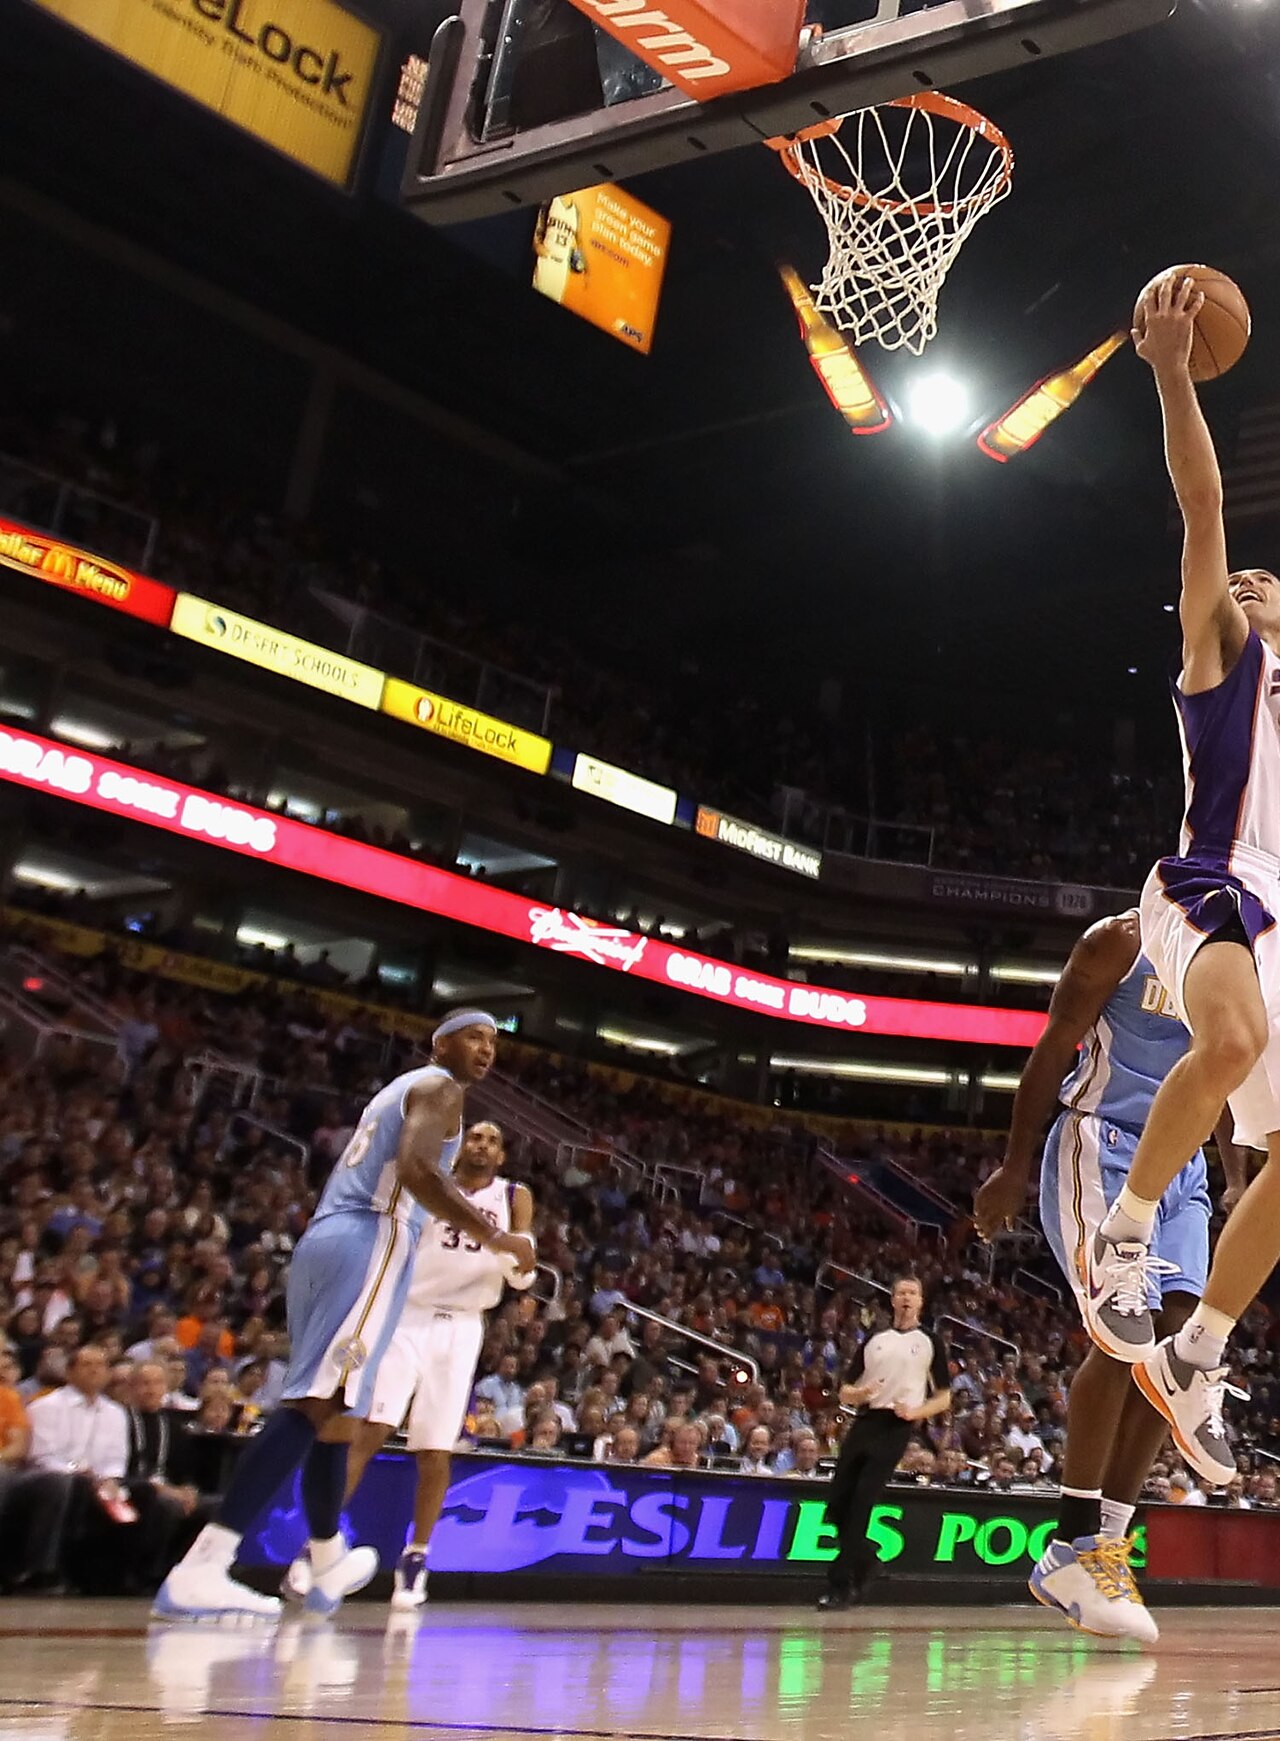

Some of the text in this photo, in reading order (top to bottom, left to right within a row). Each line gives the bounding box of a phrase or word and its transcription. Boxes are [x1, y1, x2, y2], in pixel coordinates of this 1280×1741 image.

[591, 220, 618, 245] plan
[595, 208, 663, 257] green game
[597, 192, 656, 238] Make your
[75, 560, 128, 602] Menu
[231, 623, 289, 659] DESERT
[294, 649, 359, 688] SCHOOLS
[437, 702, 518, 752] LifeLock
[783, 845, 820, 877] BANK
[931, 883, 1051, 908] CHAMPIONS
[788, 988, 866, 1026] BUDS
